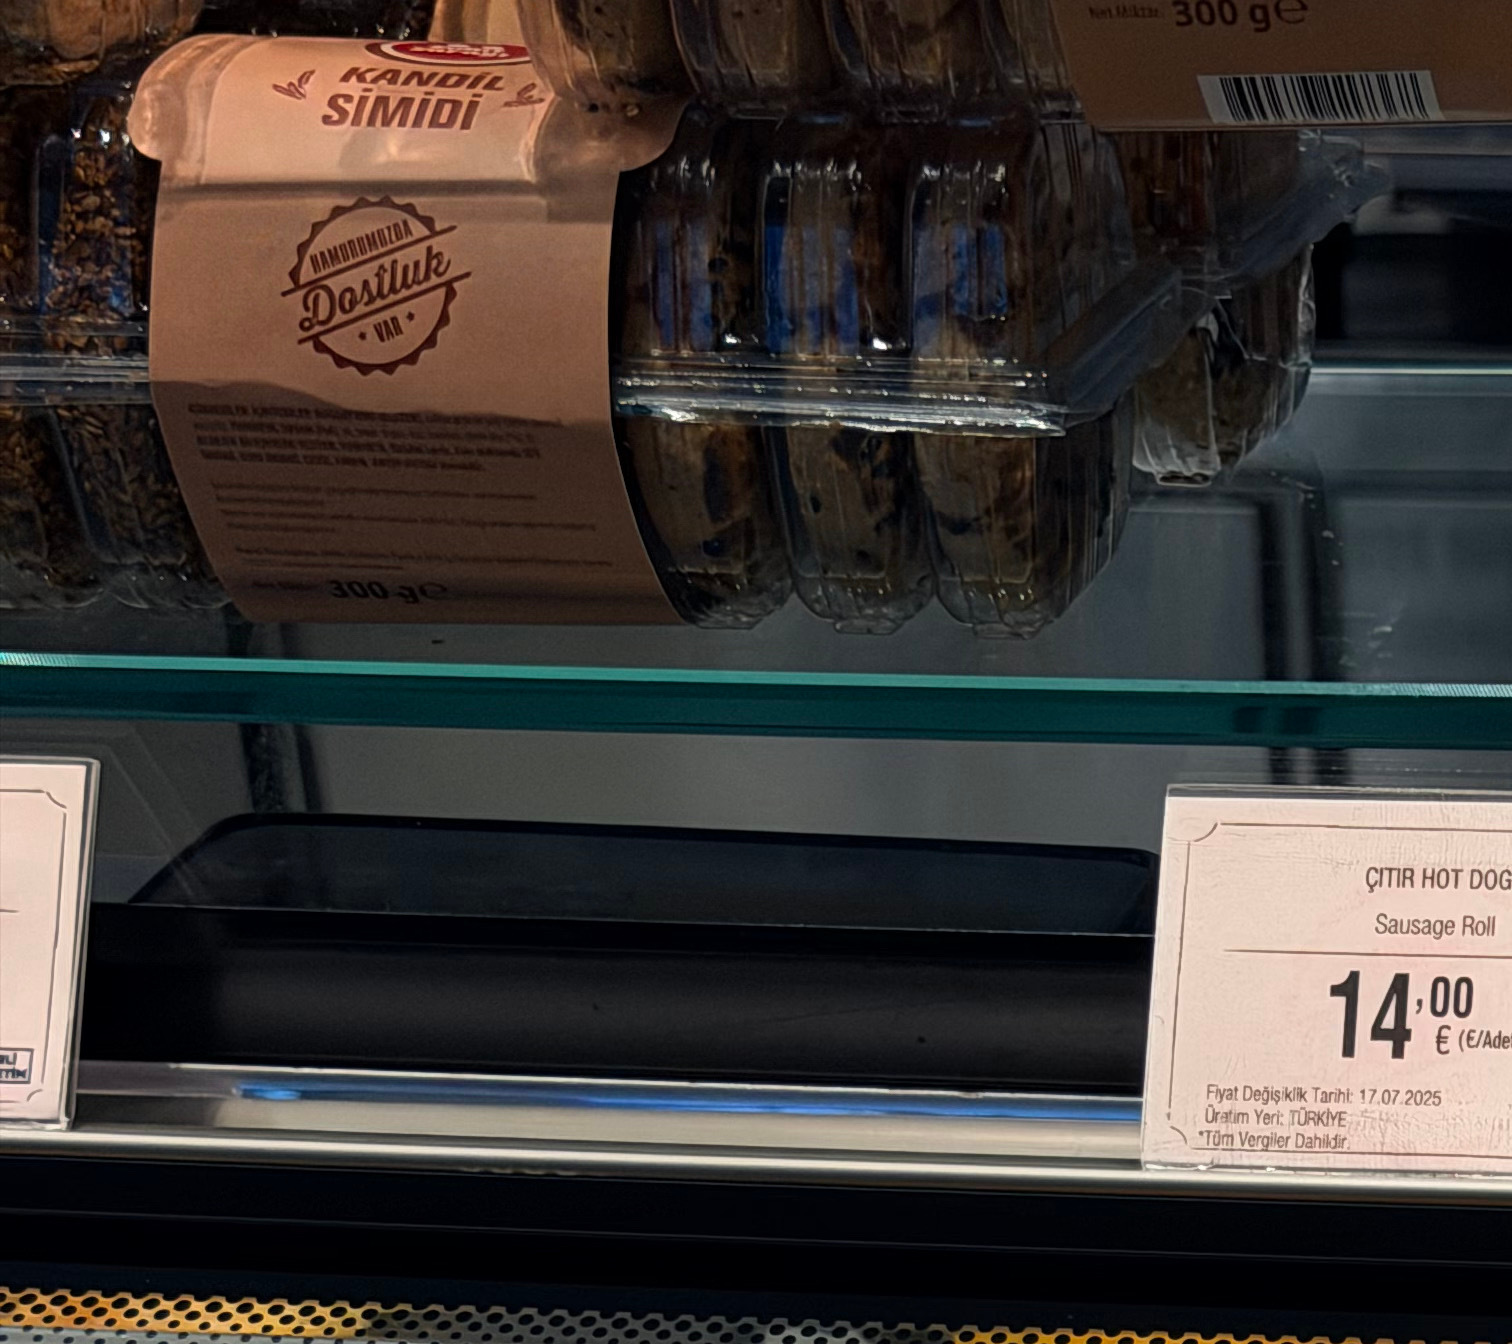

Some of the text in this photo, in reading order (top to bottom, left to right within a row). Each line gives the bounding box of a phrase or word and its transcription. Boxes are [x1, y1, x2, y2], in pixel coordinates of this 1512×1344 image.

[1171, 0, 1239, 27] 300
[338, 65, 505, 92] KANDİL
[321, 87, 484, 131] SİMİDİ
[299, 245, 451, 332] Dostluk
[373, 316, 404, 342] VAR
[1365, 867, 1512, 893] ÇITIR HOT DOG
[1374, 913, 1497, 940] Sausage Roll
[1435, 1024, 1451, 1056] €
[1206, 1084, 1443, 1106] Fiyat Değişiklik Tarihi: 17.07.2025
[1205, 1104, 1348, 1128] Üretim Yeri: TÜRKİYE
[1239, 1131, 1290, 1152] Vergiler
[1295, 1132, 1351, 1150] Dahildir.
